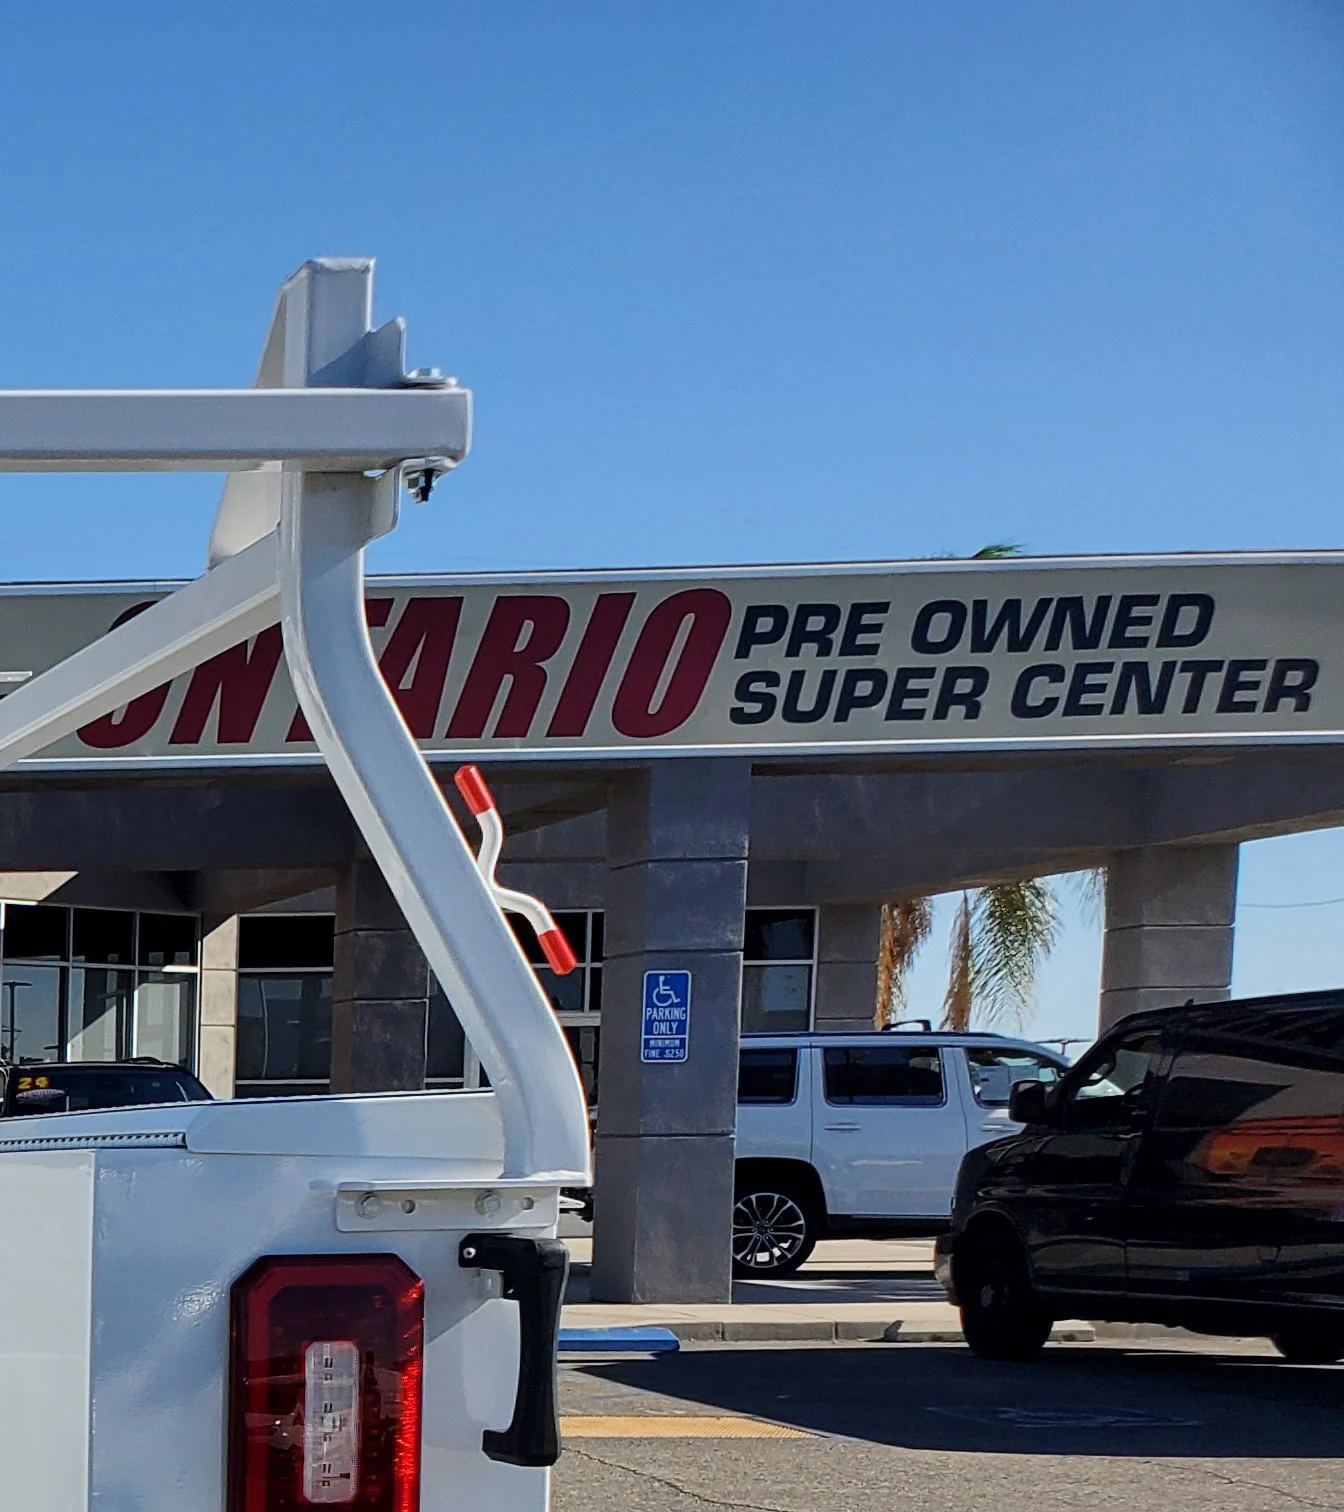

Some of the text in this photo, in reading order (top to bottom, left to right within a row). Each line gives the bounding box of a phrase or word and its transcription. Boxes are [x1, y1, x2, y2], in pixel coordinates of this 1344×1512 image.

[734, 593, 1216, 660] PRE OWNED
[729, 658, 1320, 725] SUPER CENTER
[646, 1007, 686, 1020] PARKING
[653, 1021, 678, 1035] ONLY
[644, 1048, 684, 1058] FINE $250
